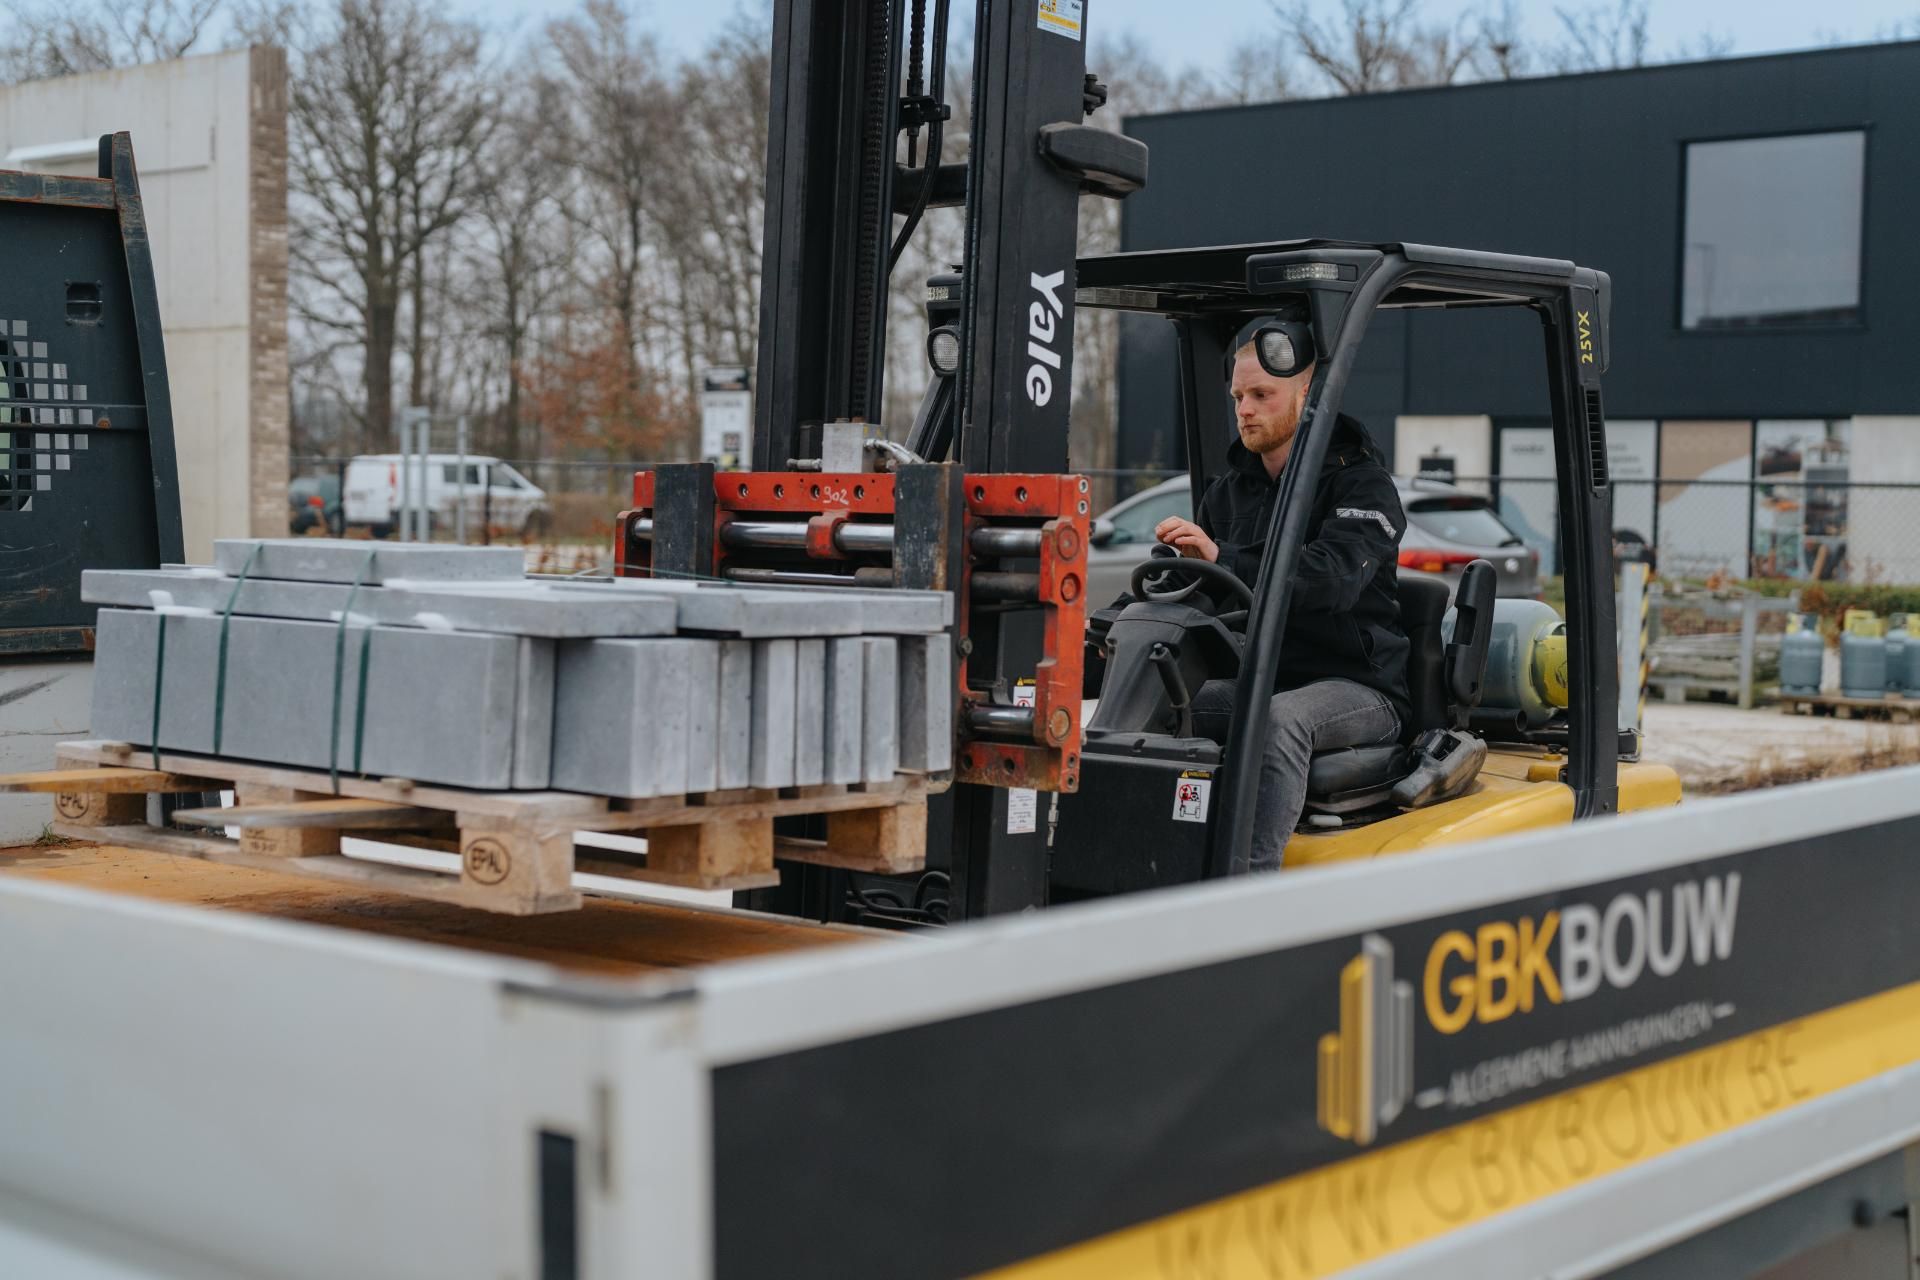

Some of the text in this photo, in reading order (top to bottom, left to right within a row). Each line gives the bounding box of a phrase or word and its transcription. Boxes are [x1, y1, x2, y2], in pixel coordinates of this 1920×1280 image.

[1026, 270, 1064, 407] Yale
[1577, 311, 1593, 364] 25VX
[1424, 872, 1741, 1034] GBKBOUW
